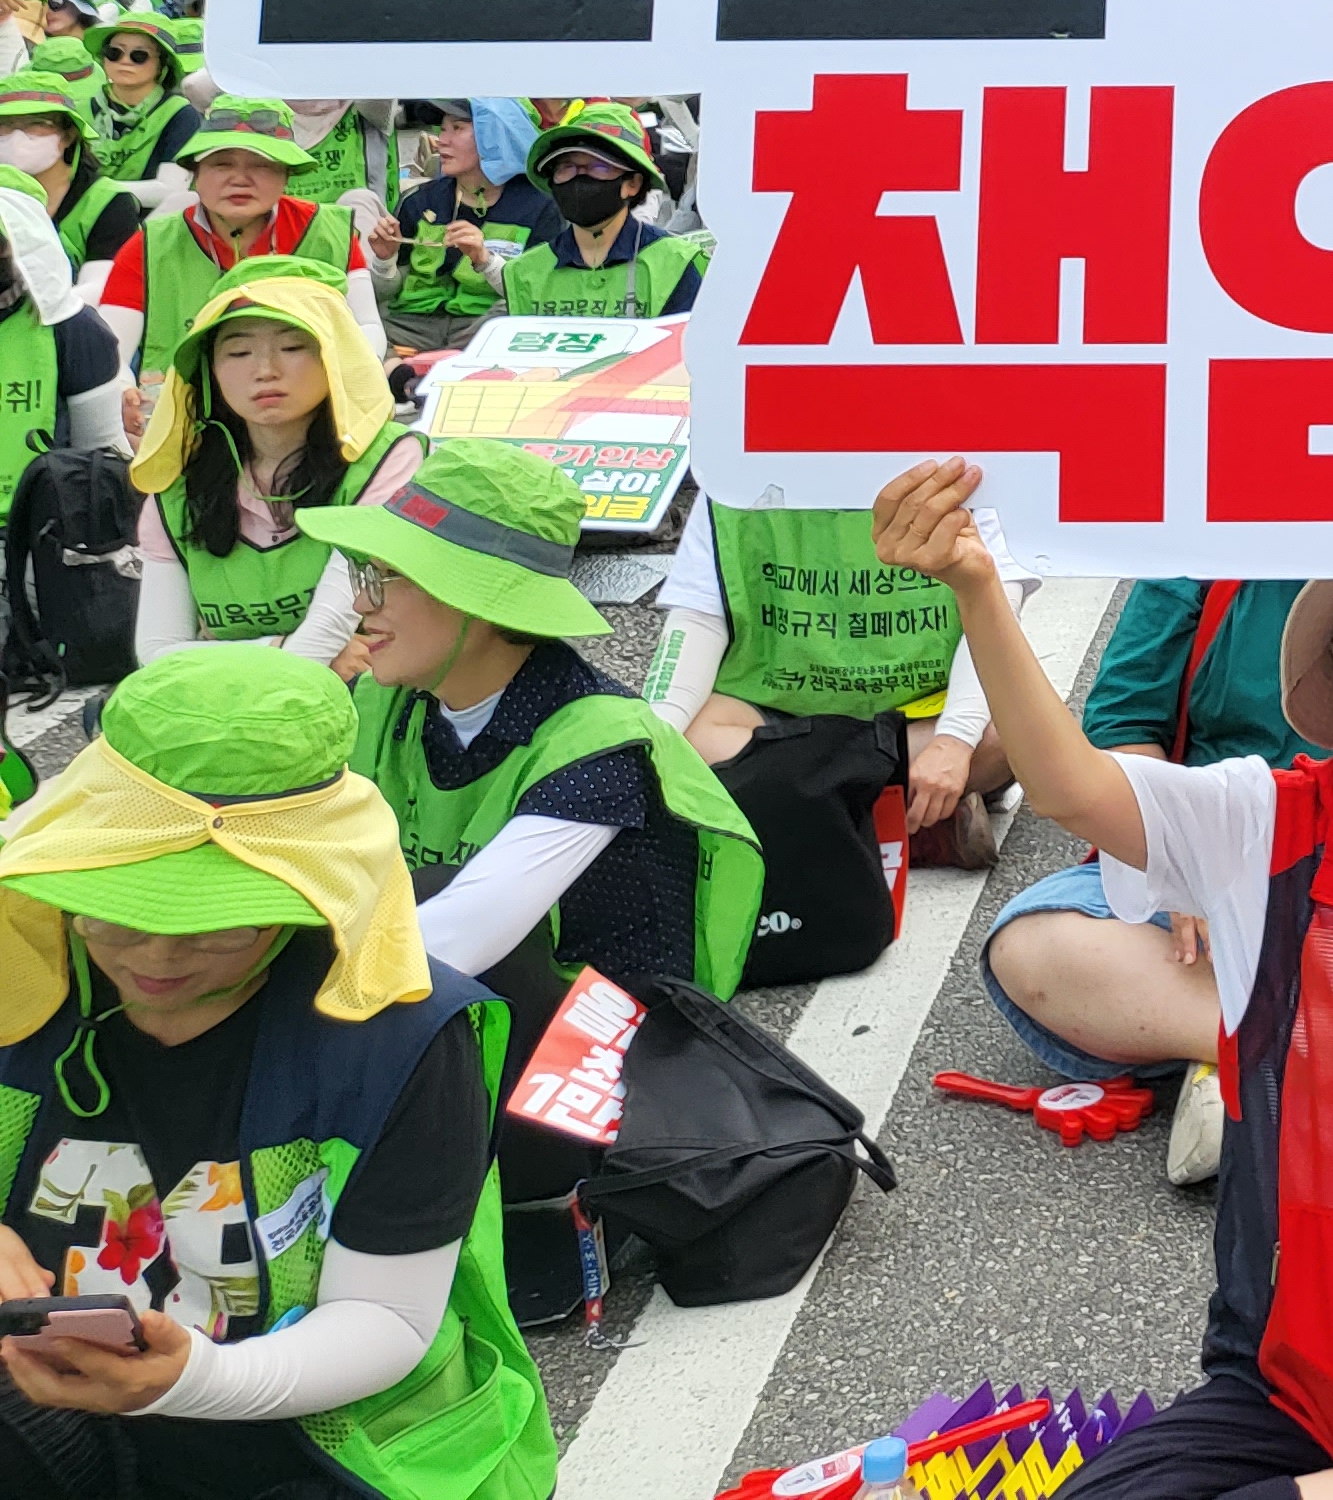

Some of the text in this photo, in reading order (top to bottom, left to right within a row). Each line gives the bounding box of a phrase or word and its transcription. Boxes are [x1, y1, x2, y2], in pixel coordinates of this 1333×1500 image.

[507, 331, 608, 353] 텅장
[0, 379, 43, 414] 취!
[580, 470, 663, 495] 살아
[760, 561, 840, 597] 학교에서
[760, 603, 949, 640] 비정규직 철폐하자!
[808, 669, 949, 695] 전국교육공무직본부
